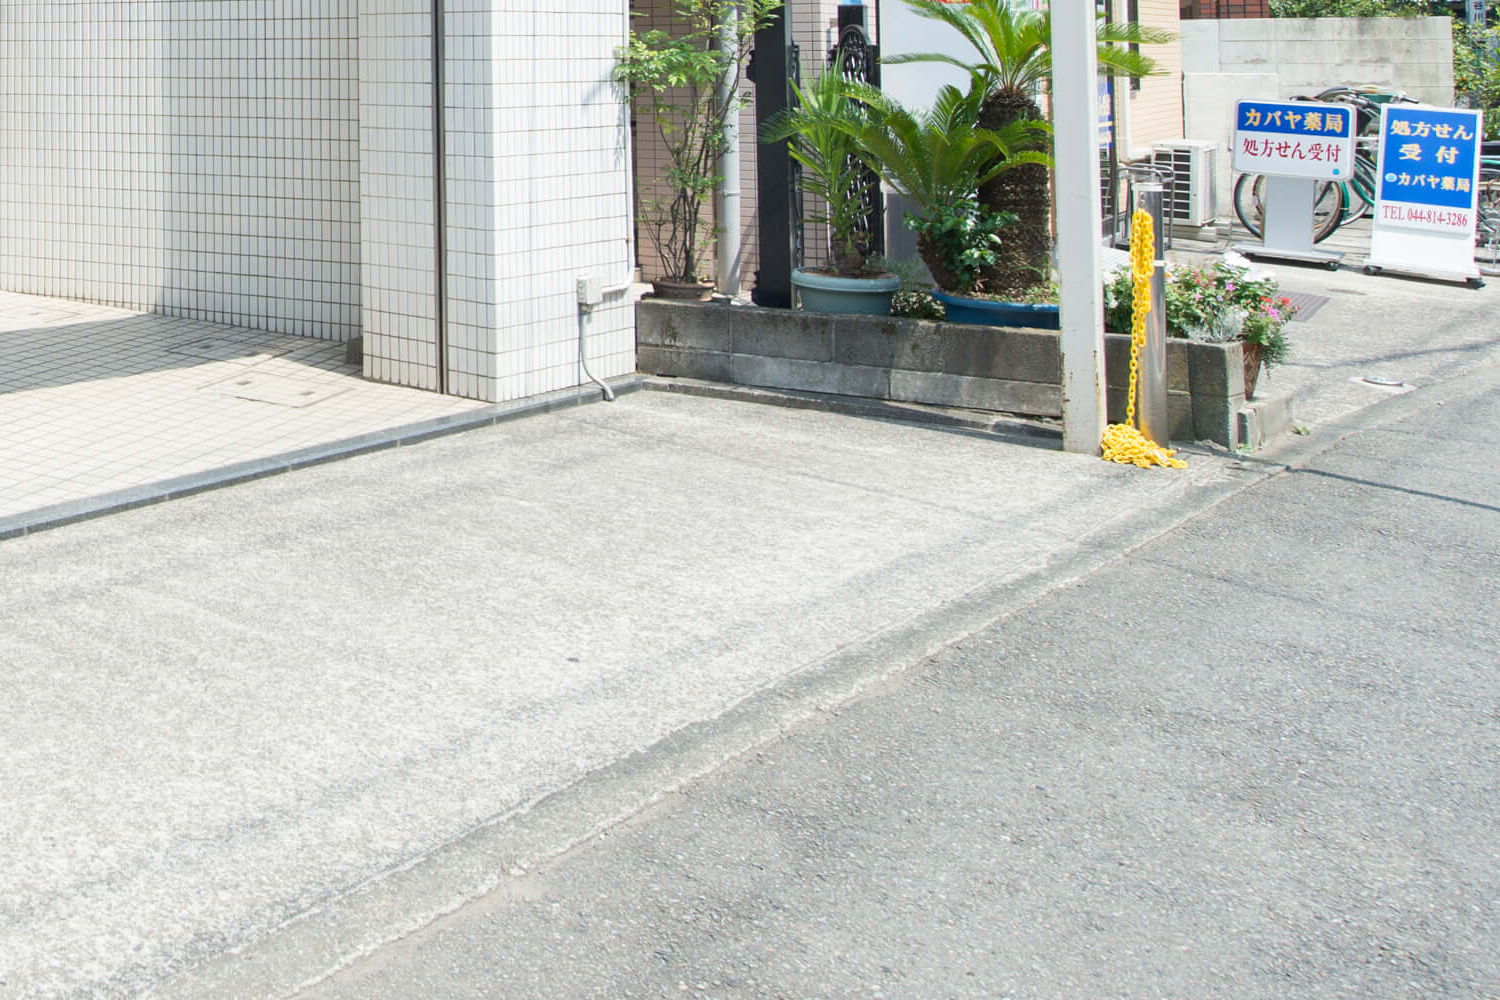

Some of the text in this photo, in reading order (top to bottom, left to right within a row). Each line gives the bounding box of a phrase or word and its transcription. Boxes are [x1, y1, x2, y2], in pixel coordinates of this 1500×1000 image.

[1390, 120, 1474, 140] 処方せん
[1243, 138, 1341, 163] 処方せん受付
[1382, 205, 1467, 226] TEL 044-814-3286
